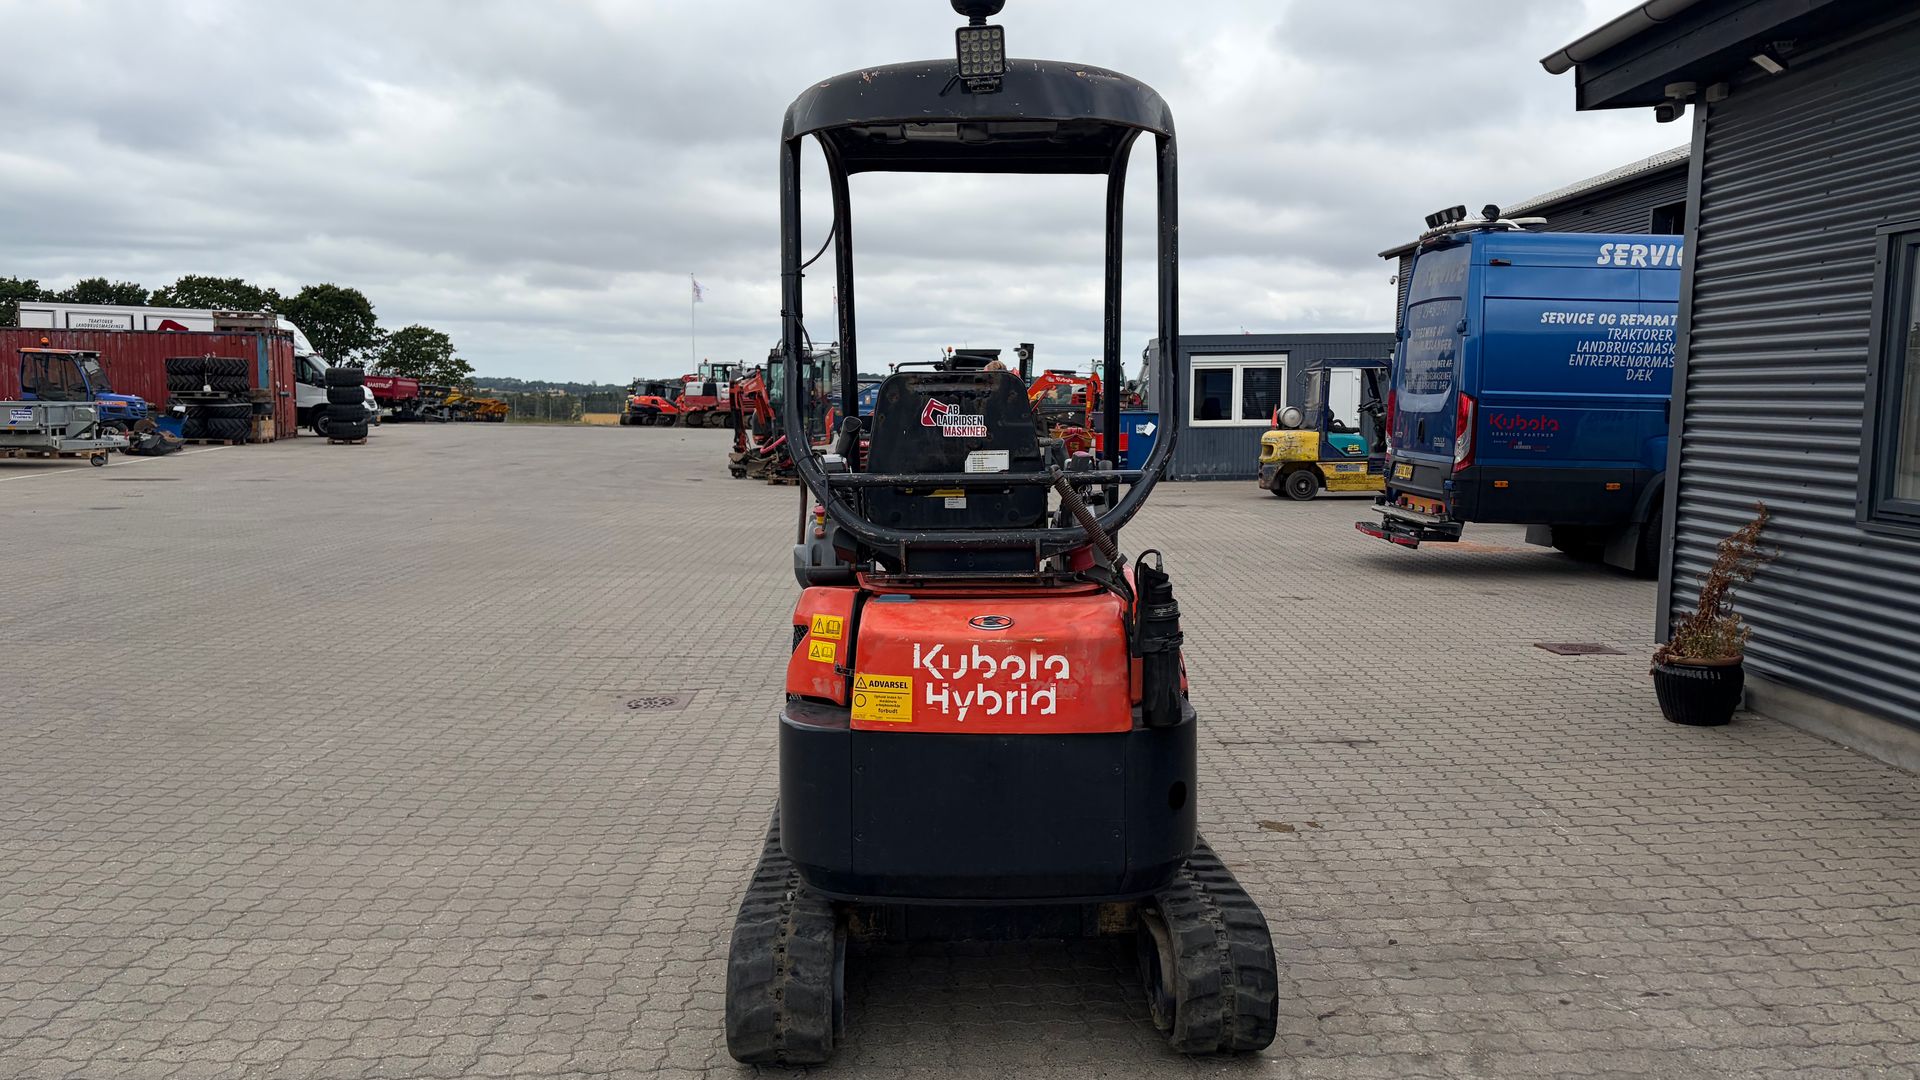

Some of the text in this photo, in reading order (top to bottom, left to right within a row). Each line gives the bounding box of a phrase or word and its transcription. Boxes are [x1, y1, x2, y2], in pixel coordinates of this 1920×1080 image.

[1541, 312, 1678, 326] SERVICE OG REPARAT
[1607, 328, 1673, 342] TRAKTORER
[1576, 341, 1676, 355] LANDBRUGSMASK
[1568, 354, 1675, 368] ENTREPRENØRMAS
[1626, 368, 1654, 382] DÆK
[948, 405, 959, 414] AB
[937, 415, 983, 426] LAURIDSEN
[1489, 413, 1560, 431] Kubota
[944, 426, 986, 436] MASKINER
[913, 643, 1070, 680] Kubota
[869, 680, 908, 689] ADVARSEL
[926, 682, 1057, 722] Hybrid
